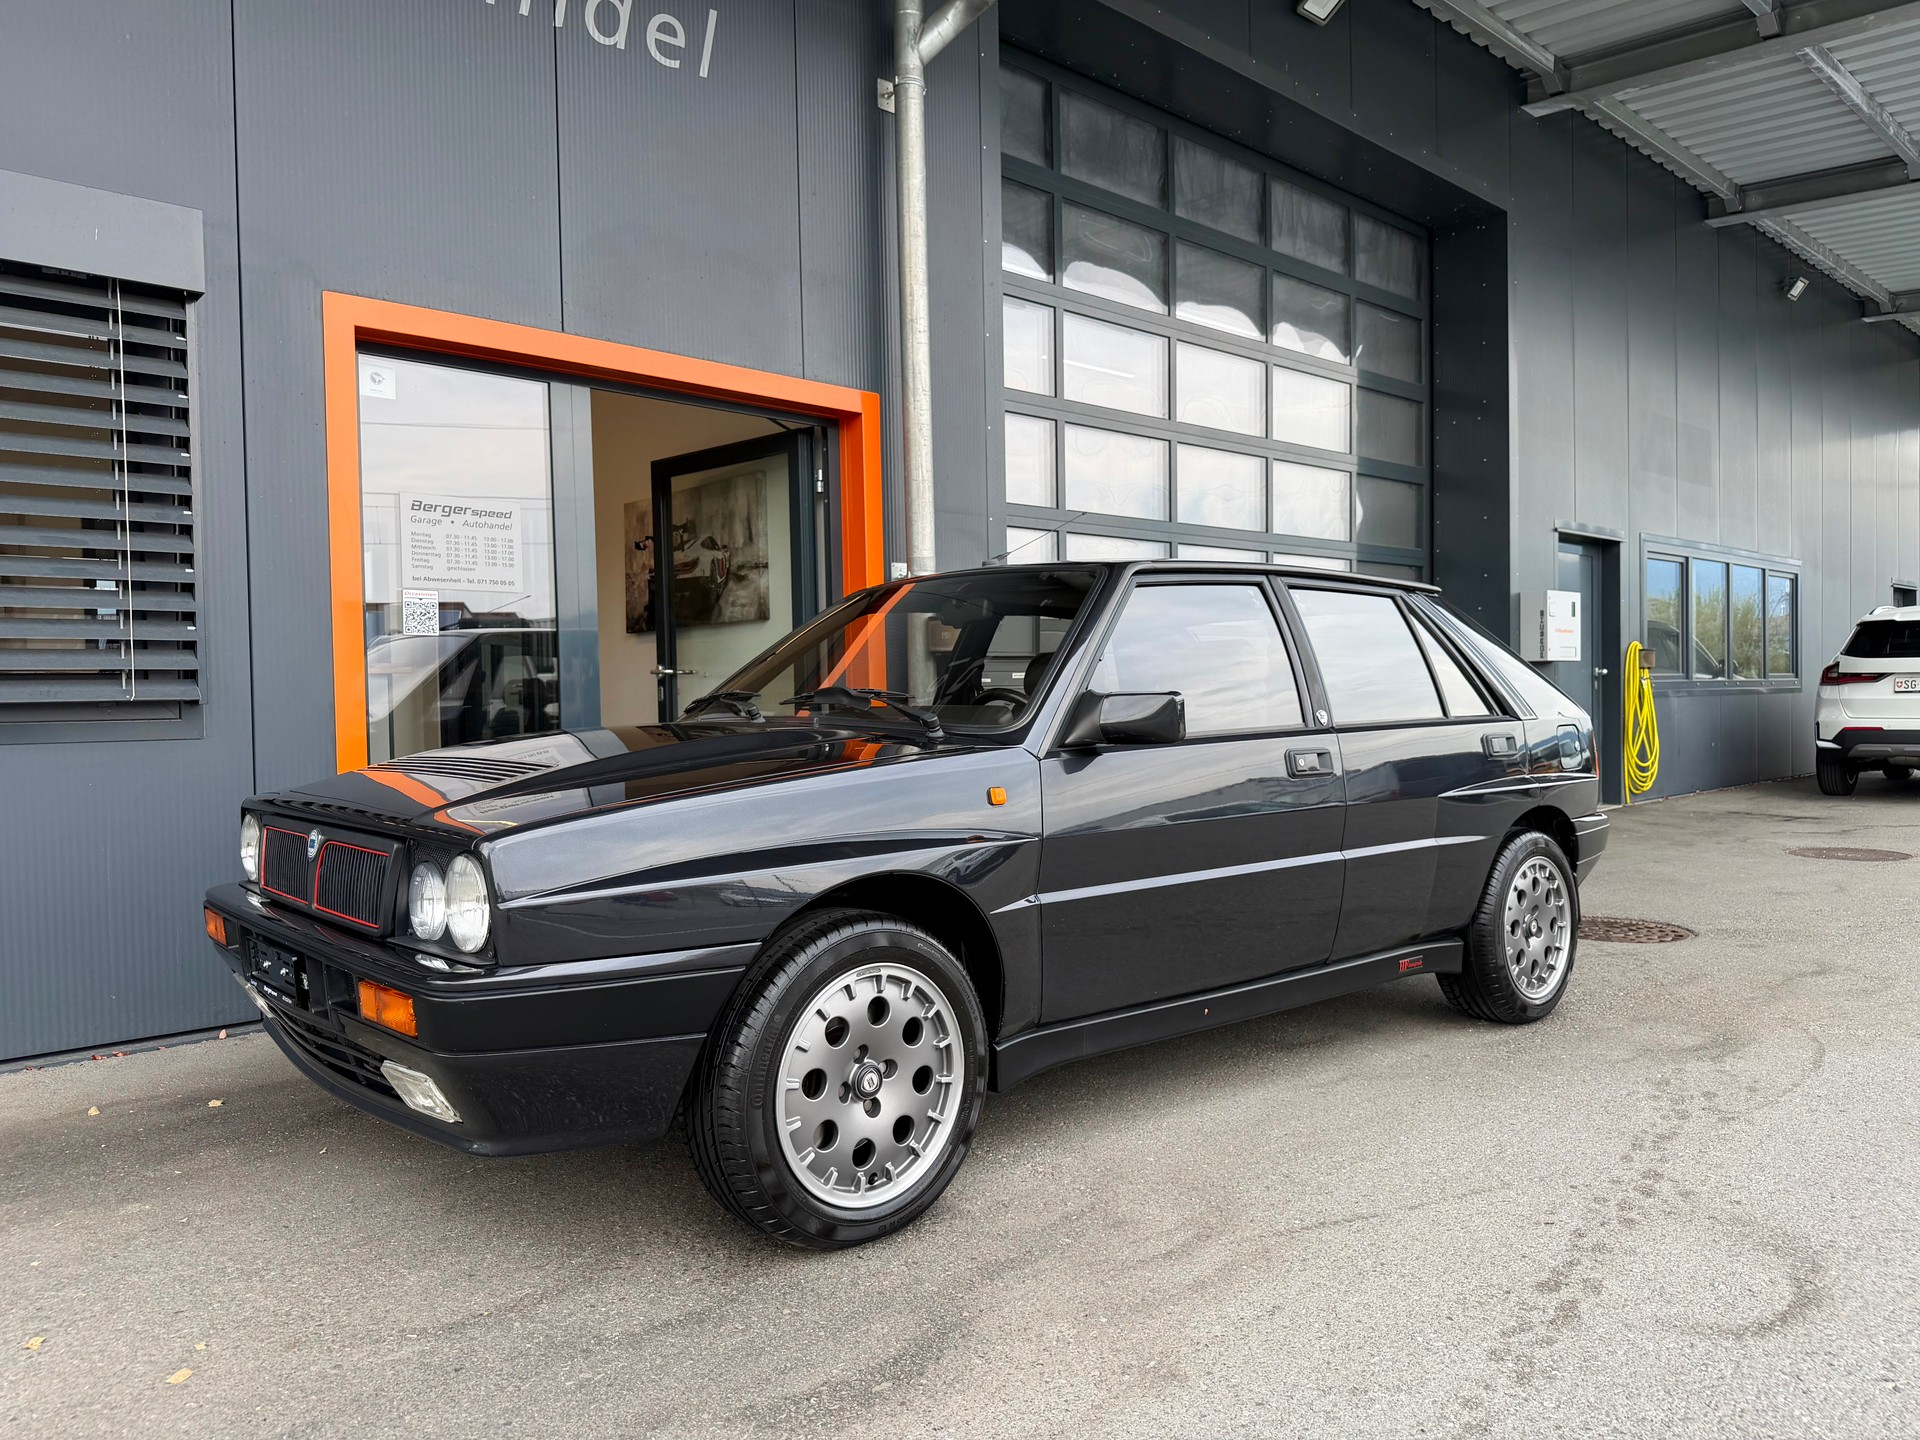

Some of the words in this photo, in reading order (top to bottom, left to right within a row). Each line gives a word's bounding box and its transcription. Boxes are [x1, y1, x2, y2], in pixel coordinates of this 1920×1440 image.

[410, 500, 512, 519] Bergerspeed
[410, 515, 443, 526] Garage
[462, 520, 513, 531] Autohandel
[423, 576, 461, 584] Abwesenheit
